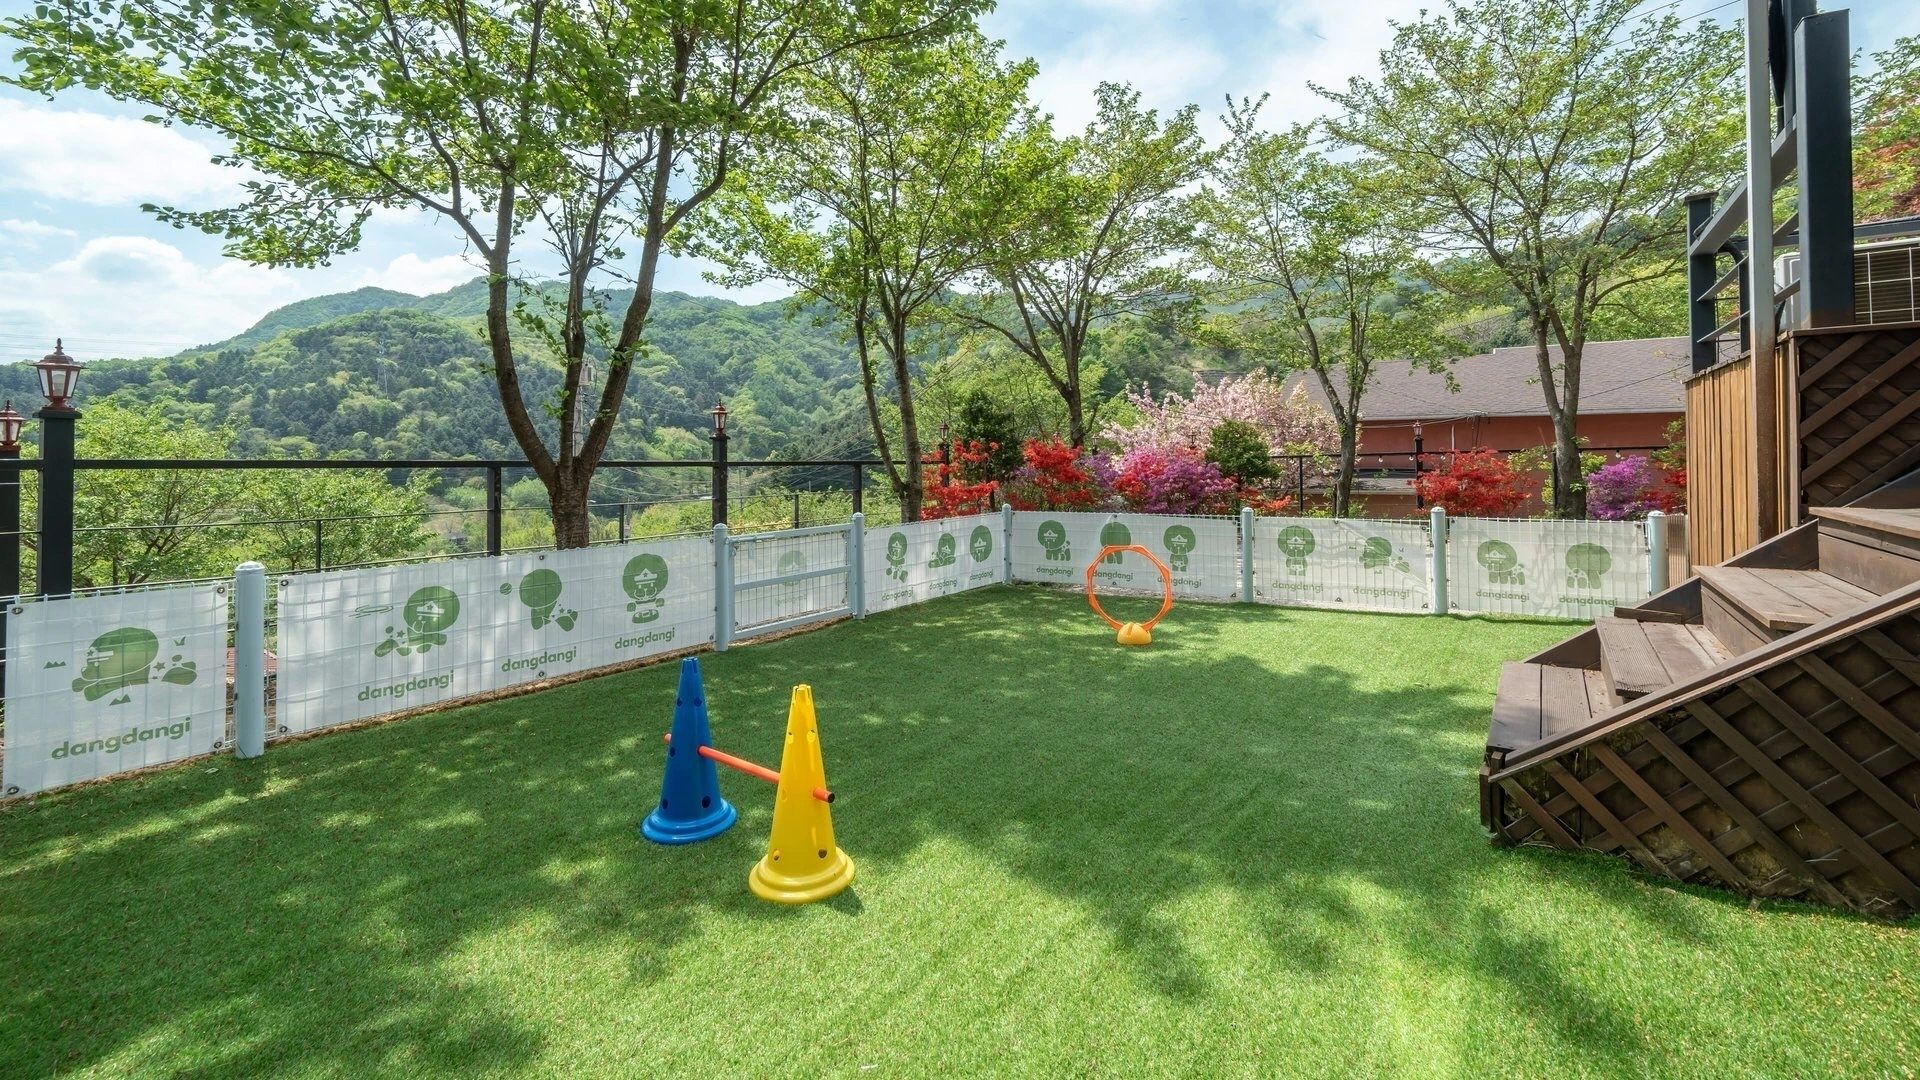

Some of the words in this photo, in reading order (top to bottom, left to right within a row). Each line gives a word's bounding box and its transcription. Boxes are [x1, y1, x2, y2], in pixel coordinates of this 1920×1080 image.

[1036, 565, 1074, 576] dangdangi
[1092, 569, 1134, 582] dangdangi
[1157, 576, 1202, 588] dgdangi
[1272, 580, 1324, 592] dangdangi
[1353, 586, 1410, 599] dangdangi
[1476, 589, 1530, 602] dangdangi
[1559, 596, 1618, 608] dangdangi
[614, 627, 676, 650] dangdangi
[501, 646, 577, 673] dangdangi
[357, 669, 455, 702] dangdangi
[51, 717, 192, 761] dangdangi
